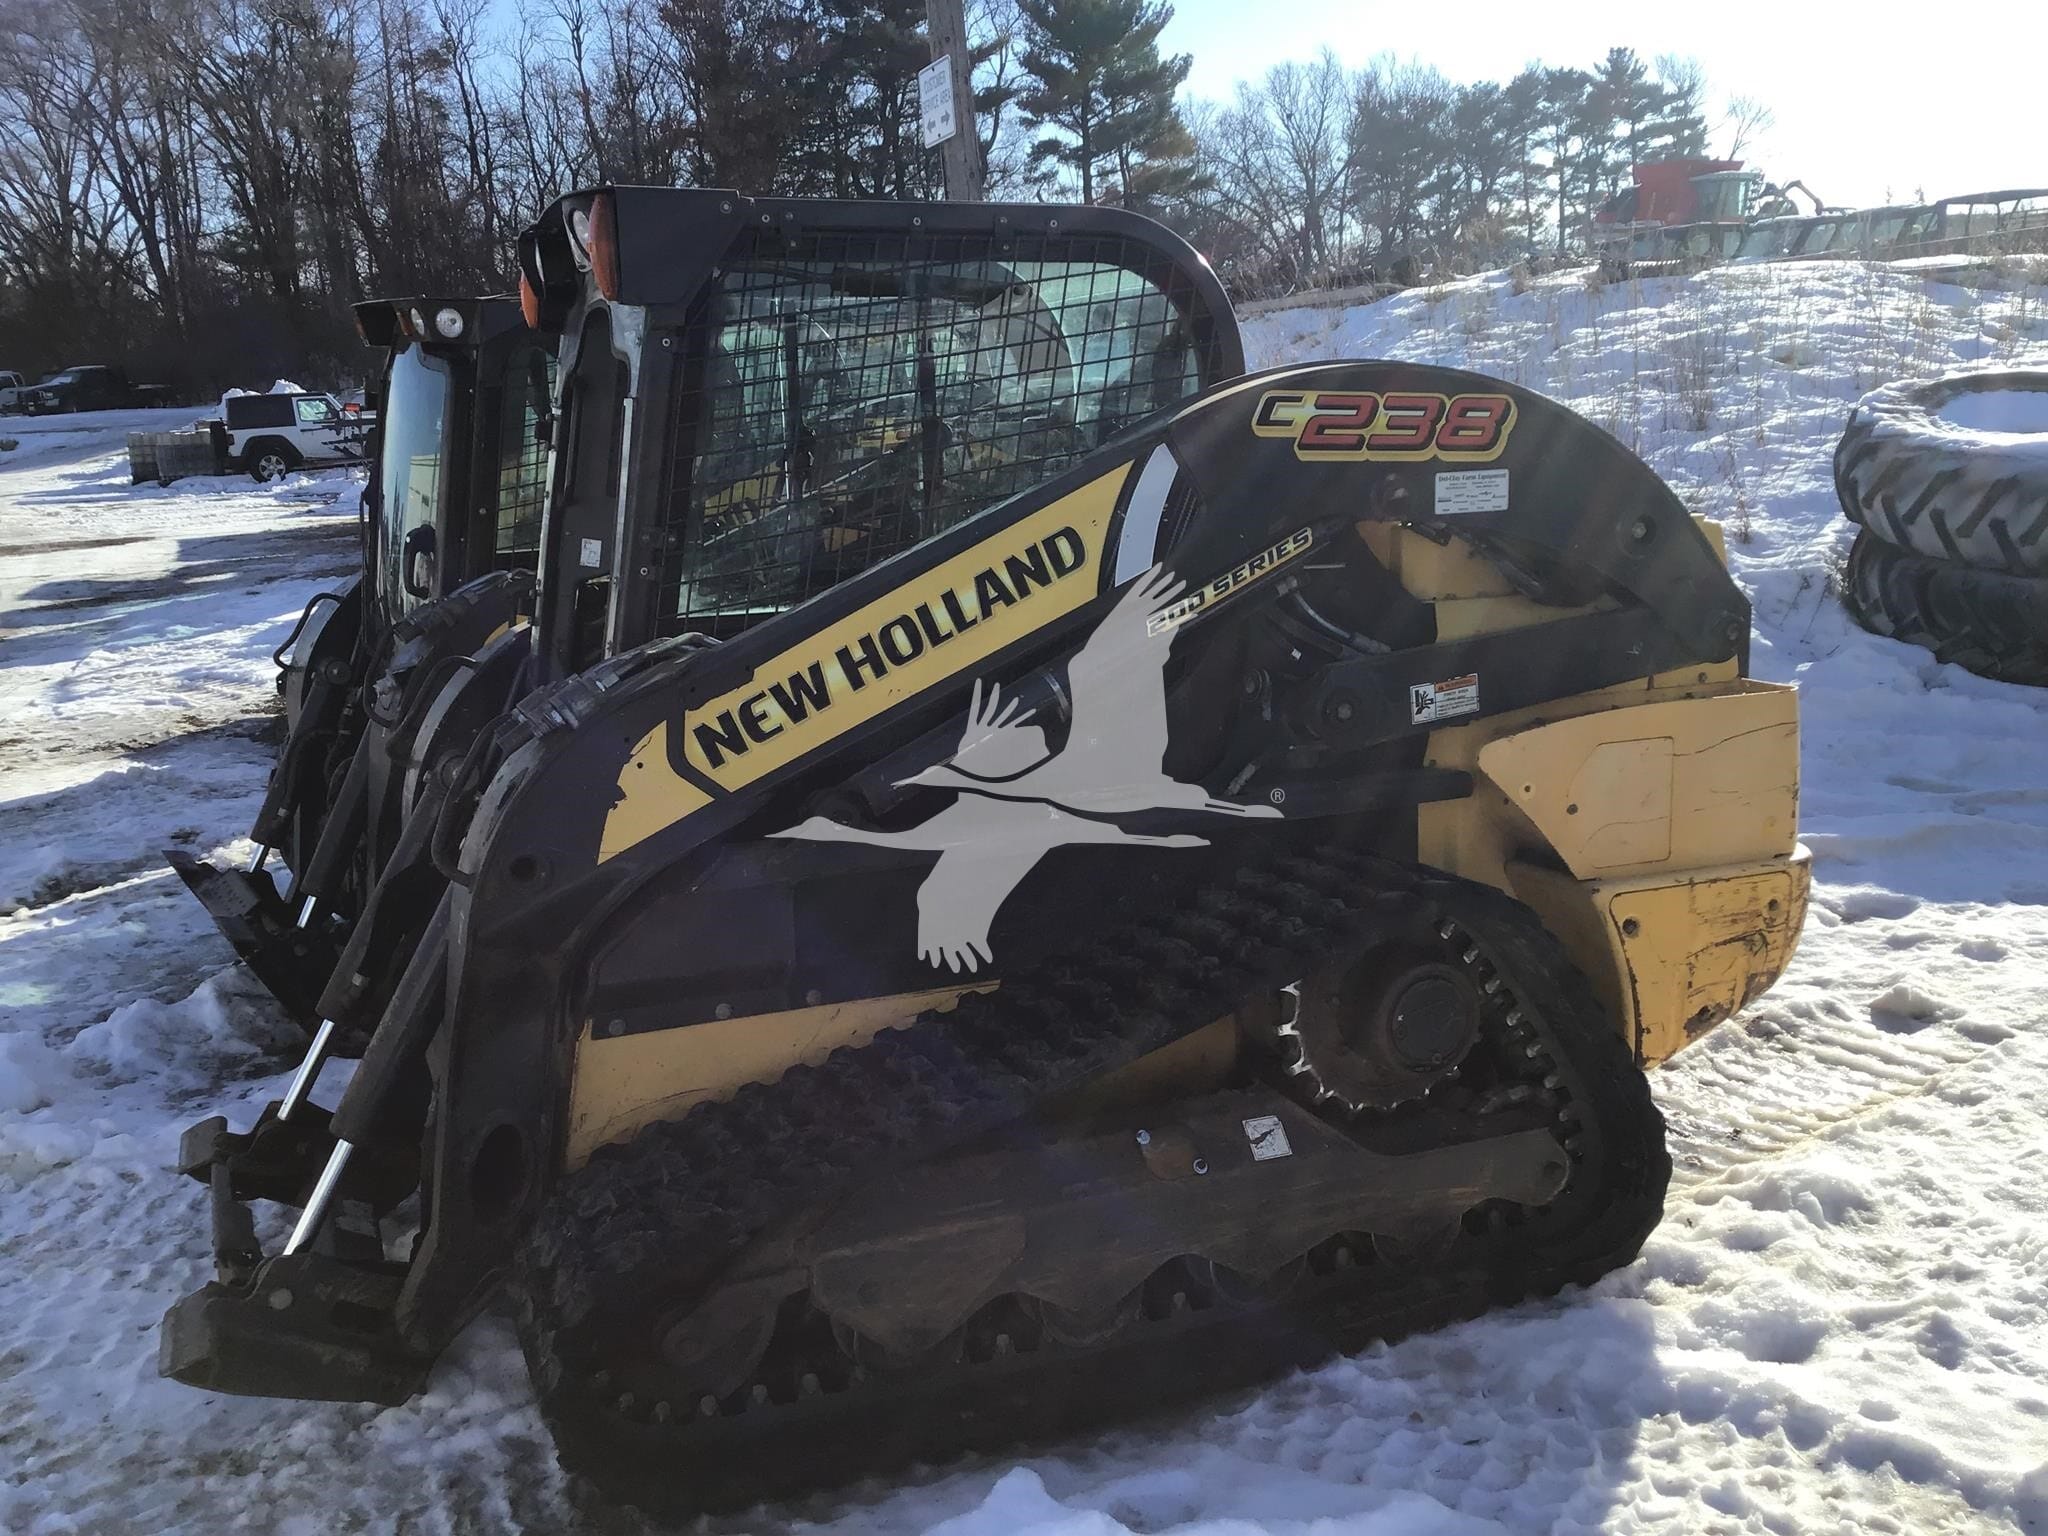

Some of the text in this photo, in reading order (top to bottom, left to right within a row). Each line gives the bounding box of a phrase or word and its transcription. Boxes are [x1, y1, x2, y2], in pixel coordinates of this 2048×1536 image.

[1253, 392, 1514, 456] C238
[1213, 528, 1310, 597] SERIES
[692, 525, 1087, 770] NEW HOLLAND
